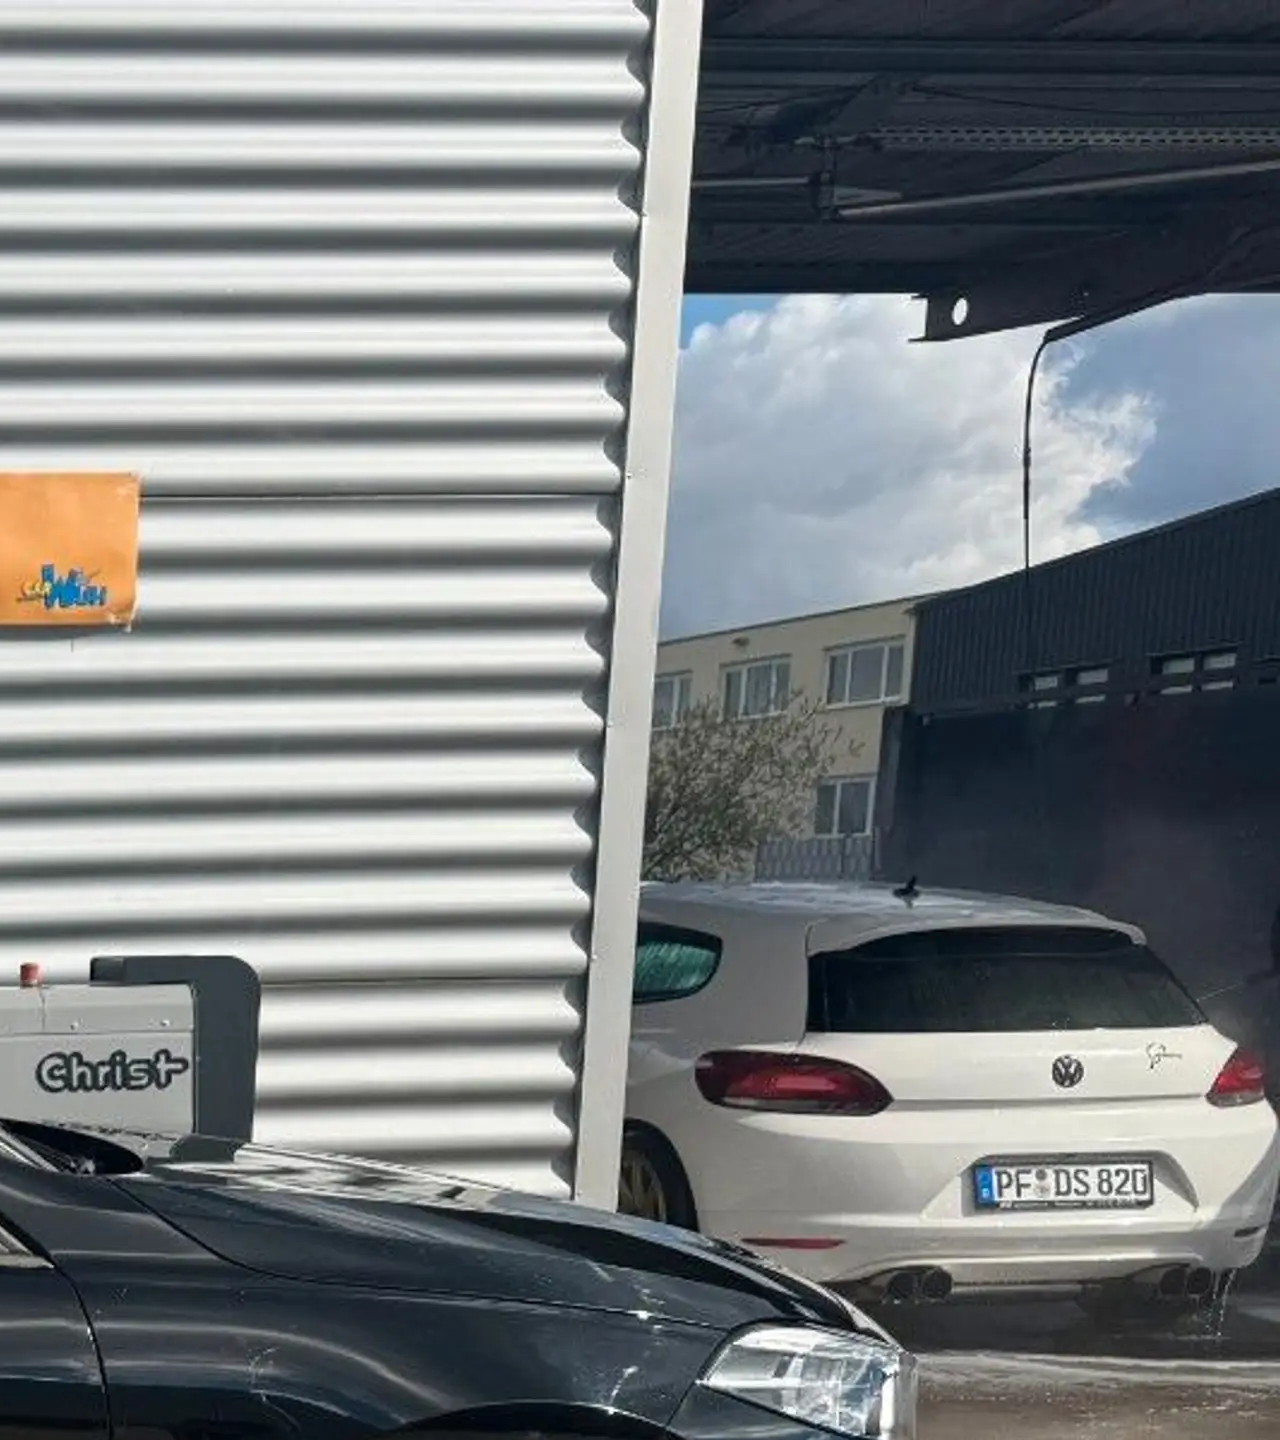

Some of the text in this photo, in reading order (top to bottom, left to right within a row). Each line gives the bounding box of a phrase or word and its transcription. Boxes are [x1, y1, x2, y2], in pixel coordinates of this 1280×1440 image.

[35, 1049, 189, 1092] Christ
[995, 1168, 1148, 1199] PF DS 820
